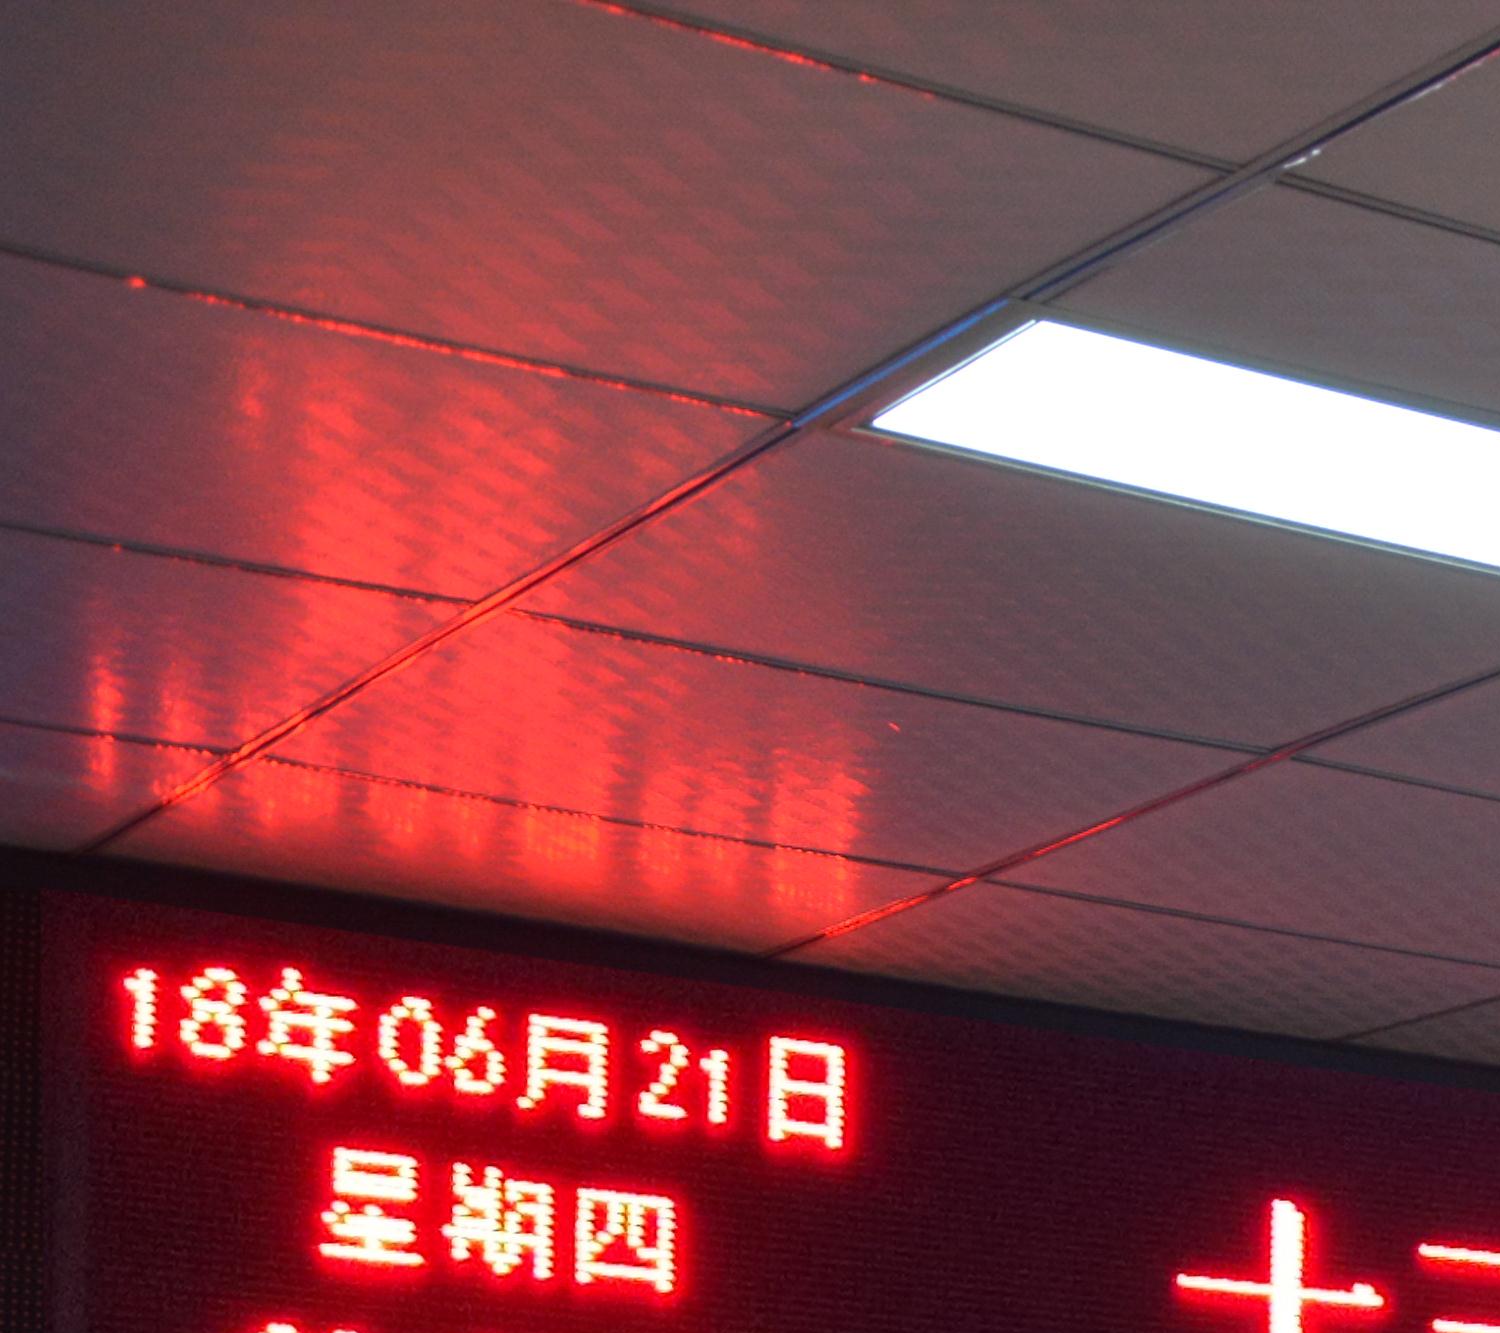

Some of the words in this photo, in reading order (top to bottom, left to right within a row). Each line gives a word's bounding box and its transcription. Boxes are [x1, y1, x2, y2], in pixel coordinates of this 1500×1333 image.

[124, 967, 846, 1150] 18年06月21日
[319, 1147, 678, 1294] 星期四
